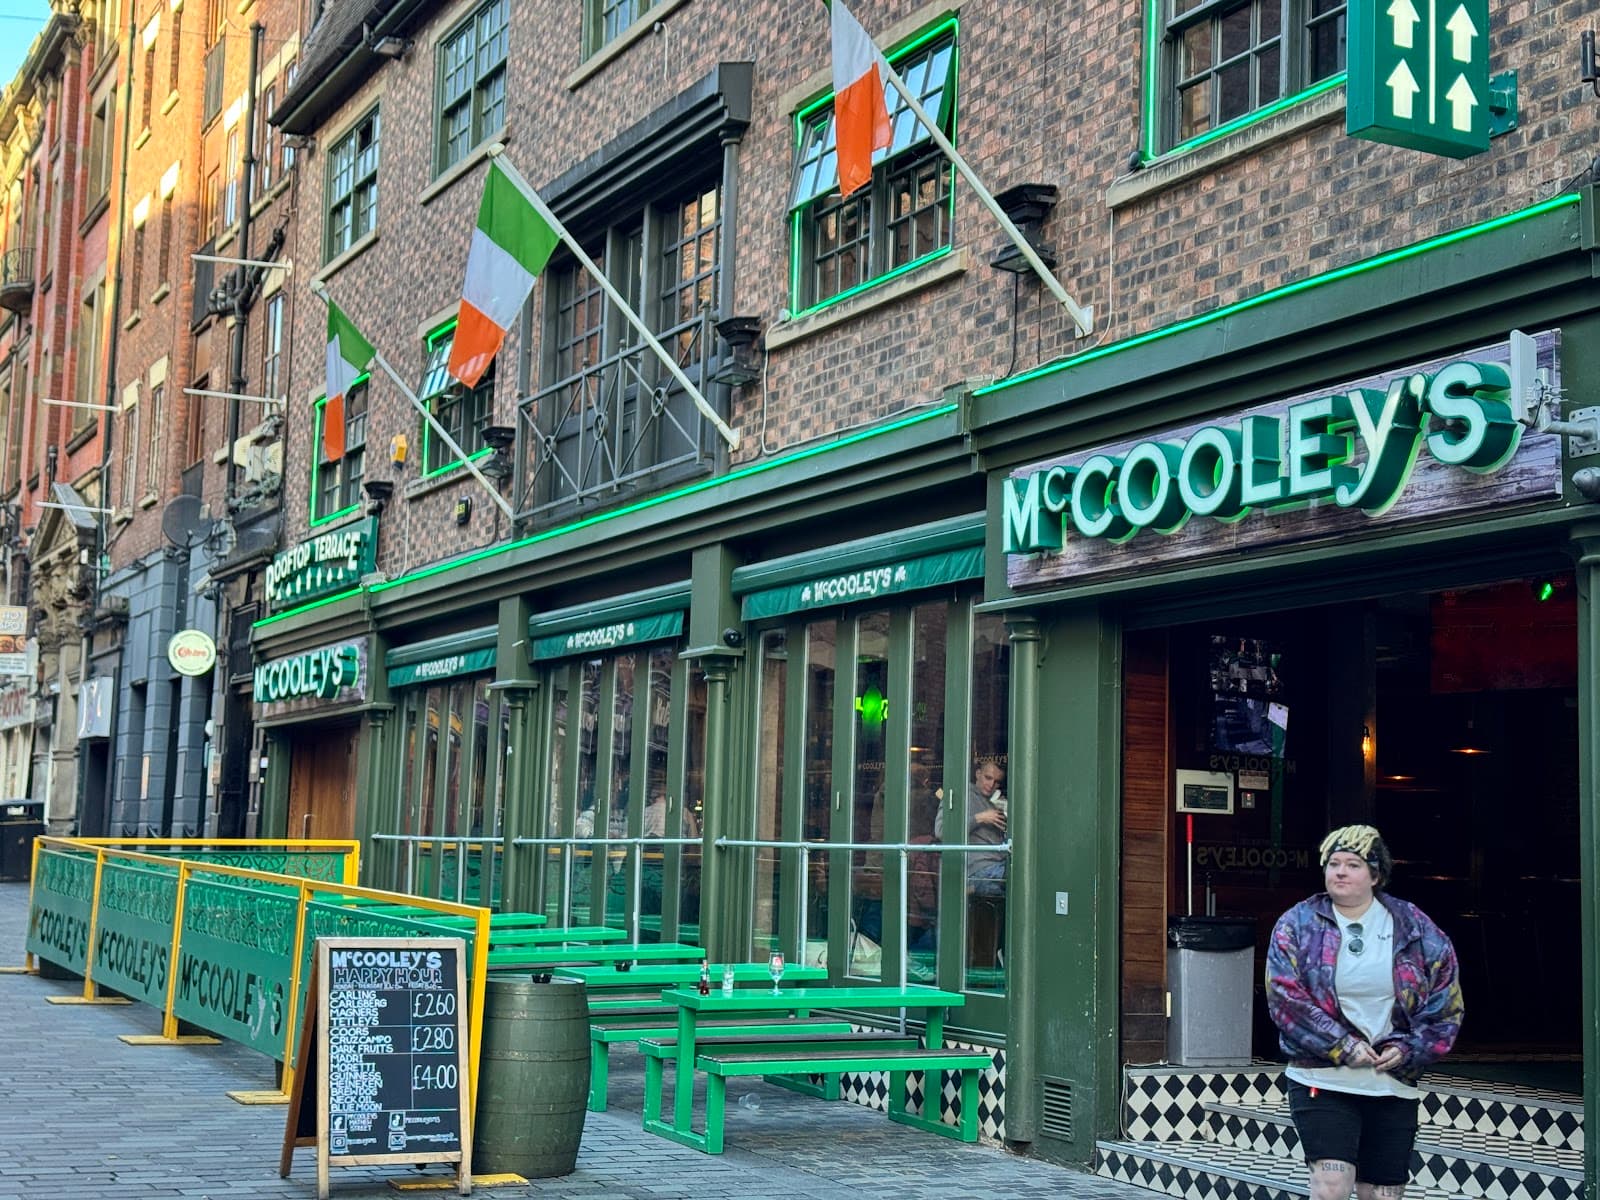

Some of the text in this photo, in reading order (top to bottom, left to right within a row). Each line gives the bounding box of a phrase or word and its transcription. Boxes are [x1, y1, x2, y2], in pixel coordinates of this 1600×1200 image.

[266, 531, 361, 600] ROOFTOP TERRACE
[333, 968, 442, 984] HAPPY HOUR
[330, 991, 377, 1000] CARLING
[330, 999, 387, 1008] CARLSBERG
[330, 1008, 379, 1017] MAGNERS
[331, 1017, 379, 1026] TETLEYS
[330, 1028, 369, 1037] COORS
[330, 1044, 393, 1054] DARK FRUITS
[331, 1054, 363, 1063] MADRI
[331, 1063, 376, 1072] MORETTI
[330, 1072, 382, 1081] GUINNESS
[412, 1064, 457, 1090] £4.00
[330, 1080, 383, 1089] HEINEKEN
[330, 1096, 376, 1104] NECK OIL
[331, 1103, 382, 1112] BLUE MOON
